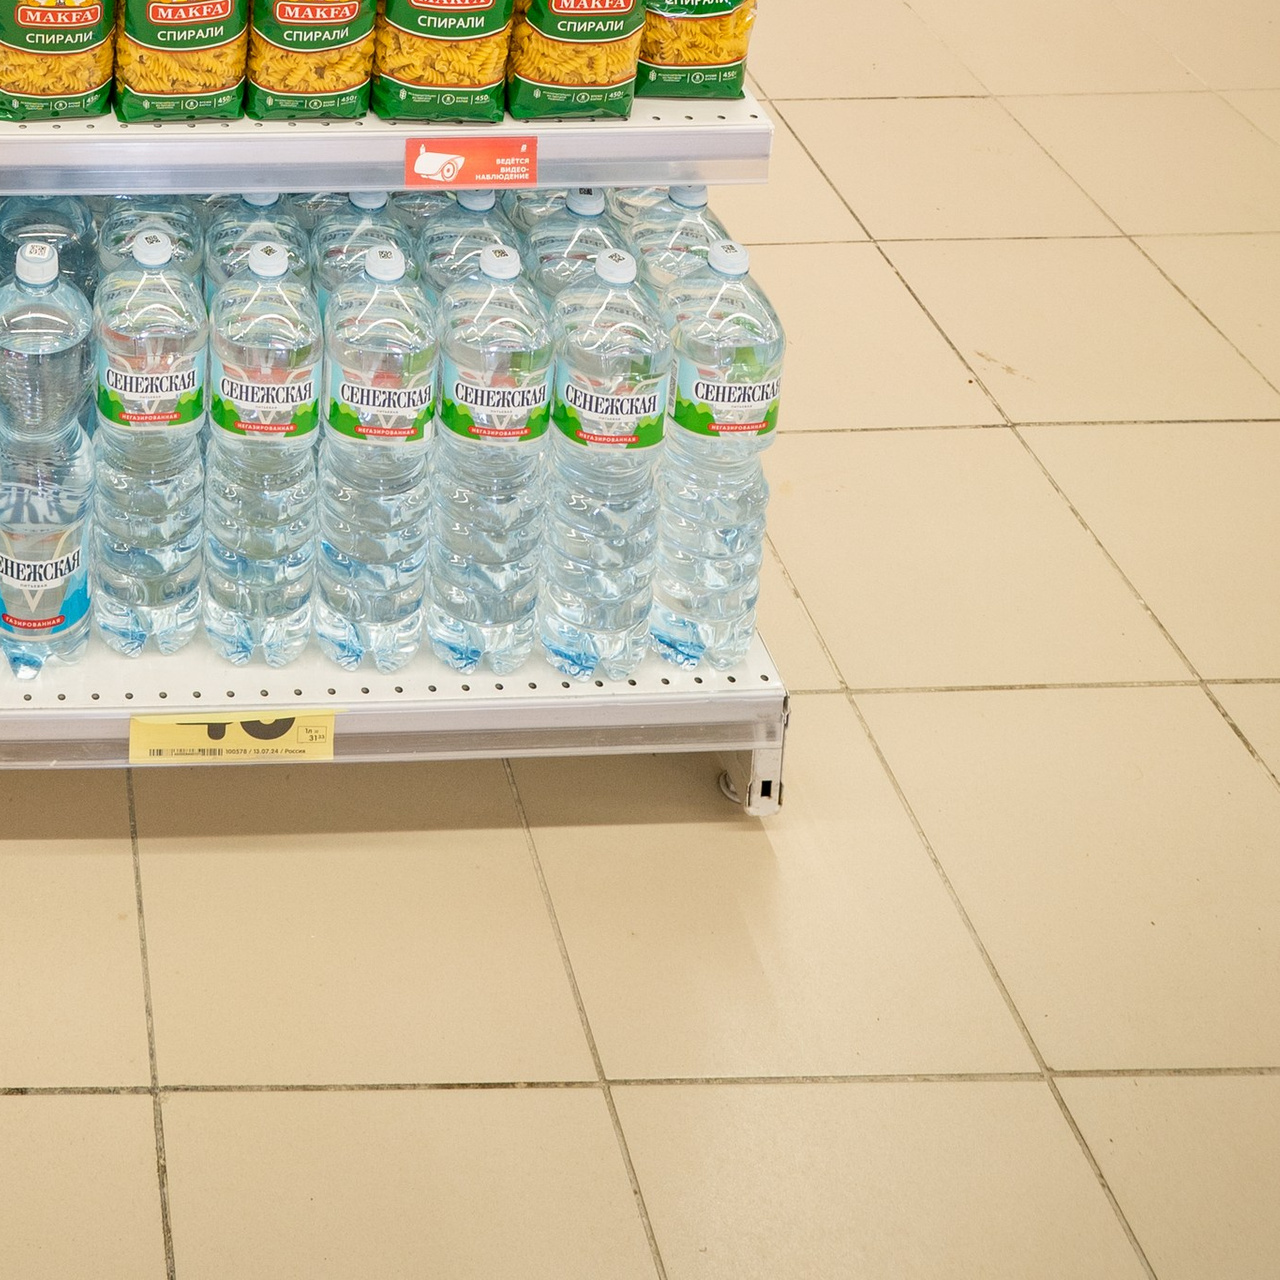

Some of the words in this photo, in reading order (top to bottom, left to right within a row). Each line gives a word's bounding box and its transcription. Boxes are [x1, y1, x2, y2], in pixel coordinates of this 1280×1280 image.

[417, 15, 485, 29] СПИРАЛИ
[106, 370, 195, 393] СЕНЕЖСКАЯ
[456, 382, 546, 408] СЕНЕЖСКАЯ
[565, 385, 657, 414] СЕНЕЖСКАЯ
[358, 427, 415, 436] НЕГАЗИРОВАННАЯ
[6, 616, 61, 626] ГАЗИРОВАННАЯ
